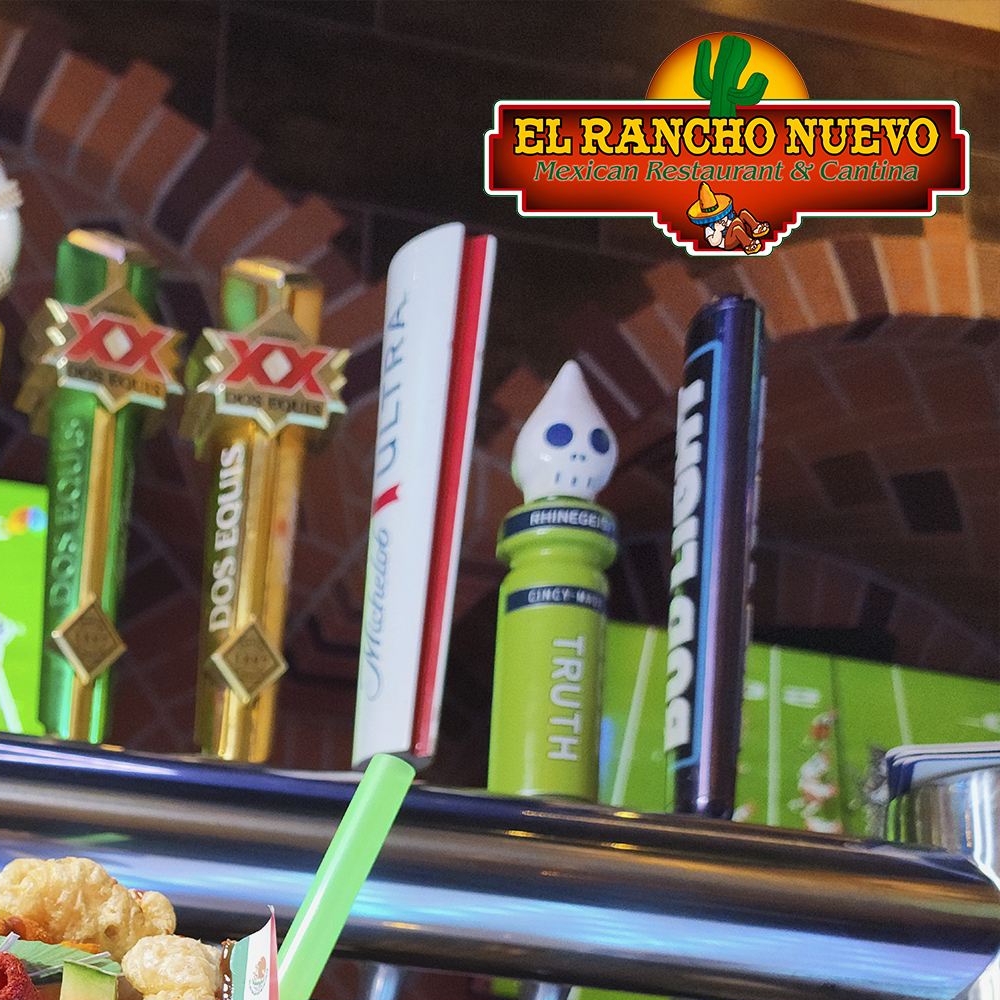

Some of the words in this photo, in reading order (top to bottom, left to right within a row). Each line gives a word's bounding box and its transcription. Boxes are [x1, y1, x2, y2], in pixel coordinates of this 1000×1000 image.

[214, 440, 246, 551] EQUIS
[361, 526, 390, 701] Michelob
[376, 288, 408, 478] ULTRA
[208, 554, 237, 633] DOS
[547, 635, 585, 763] TRUTH
